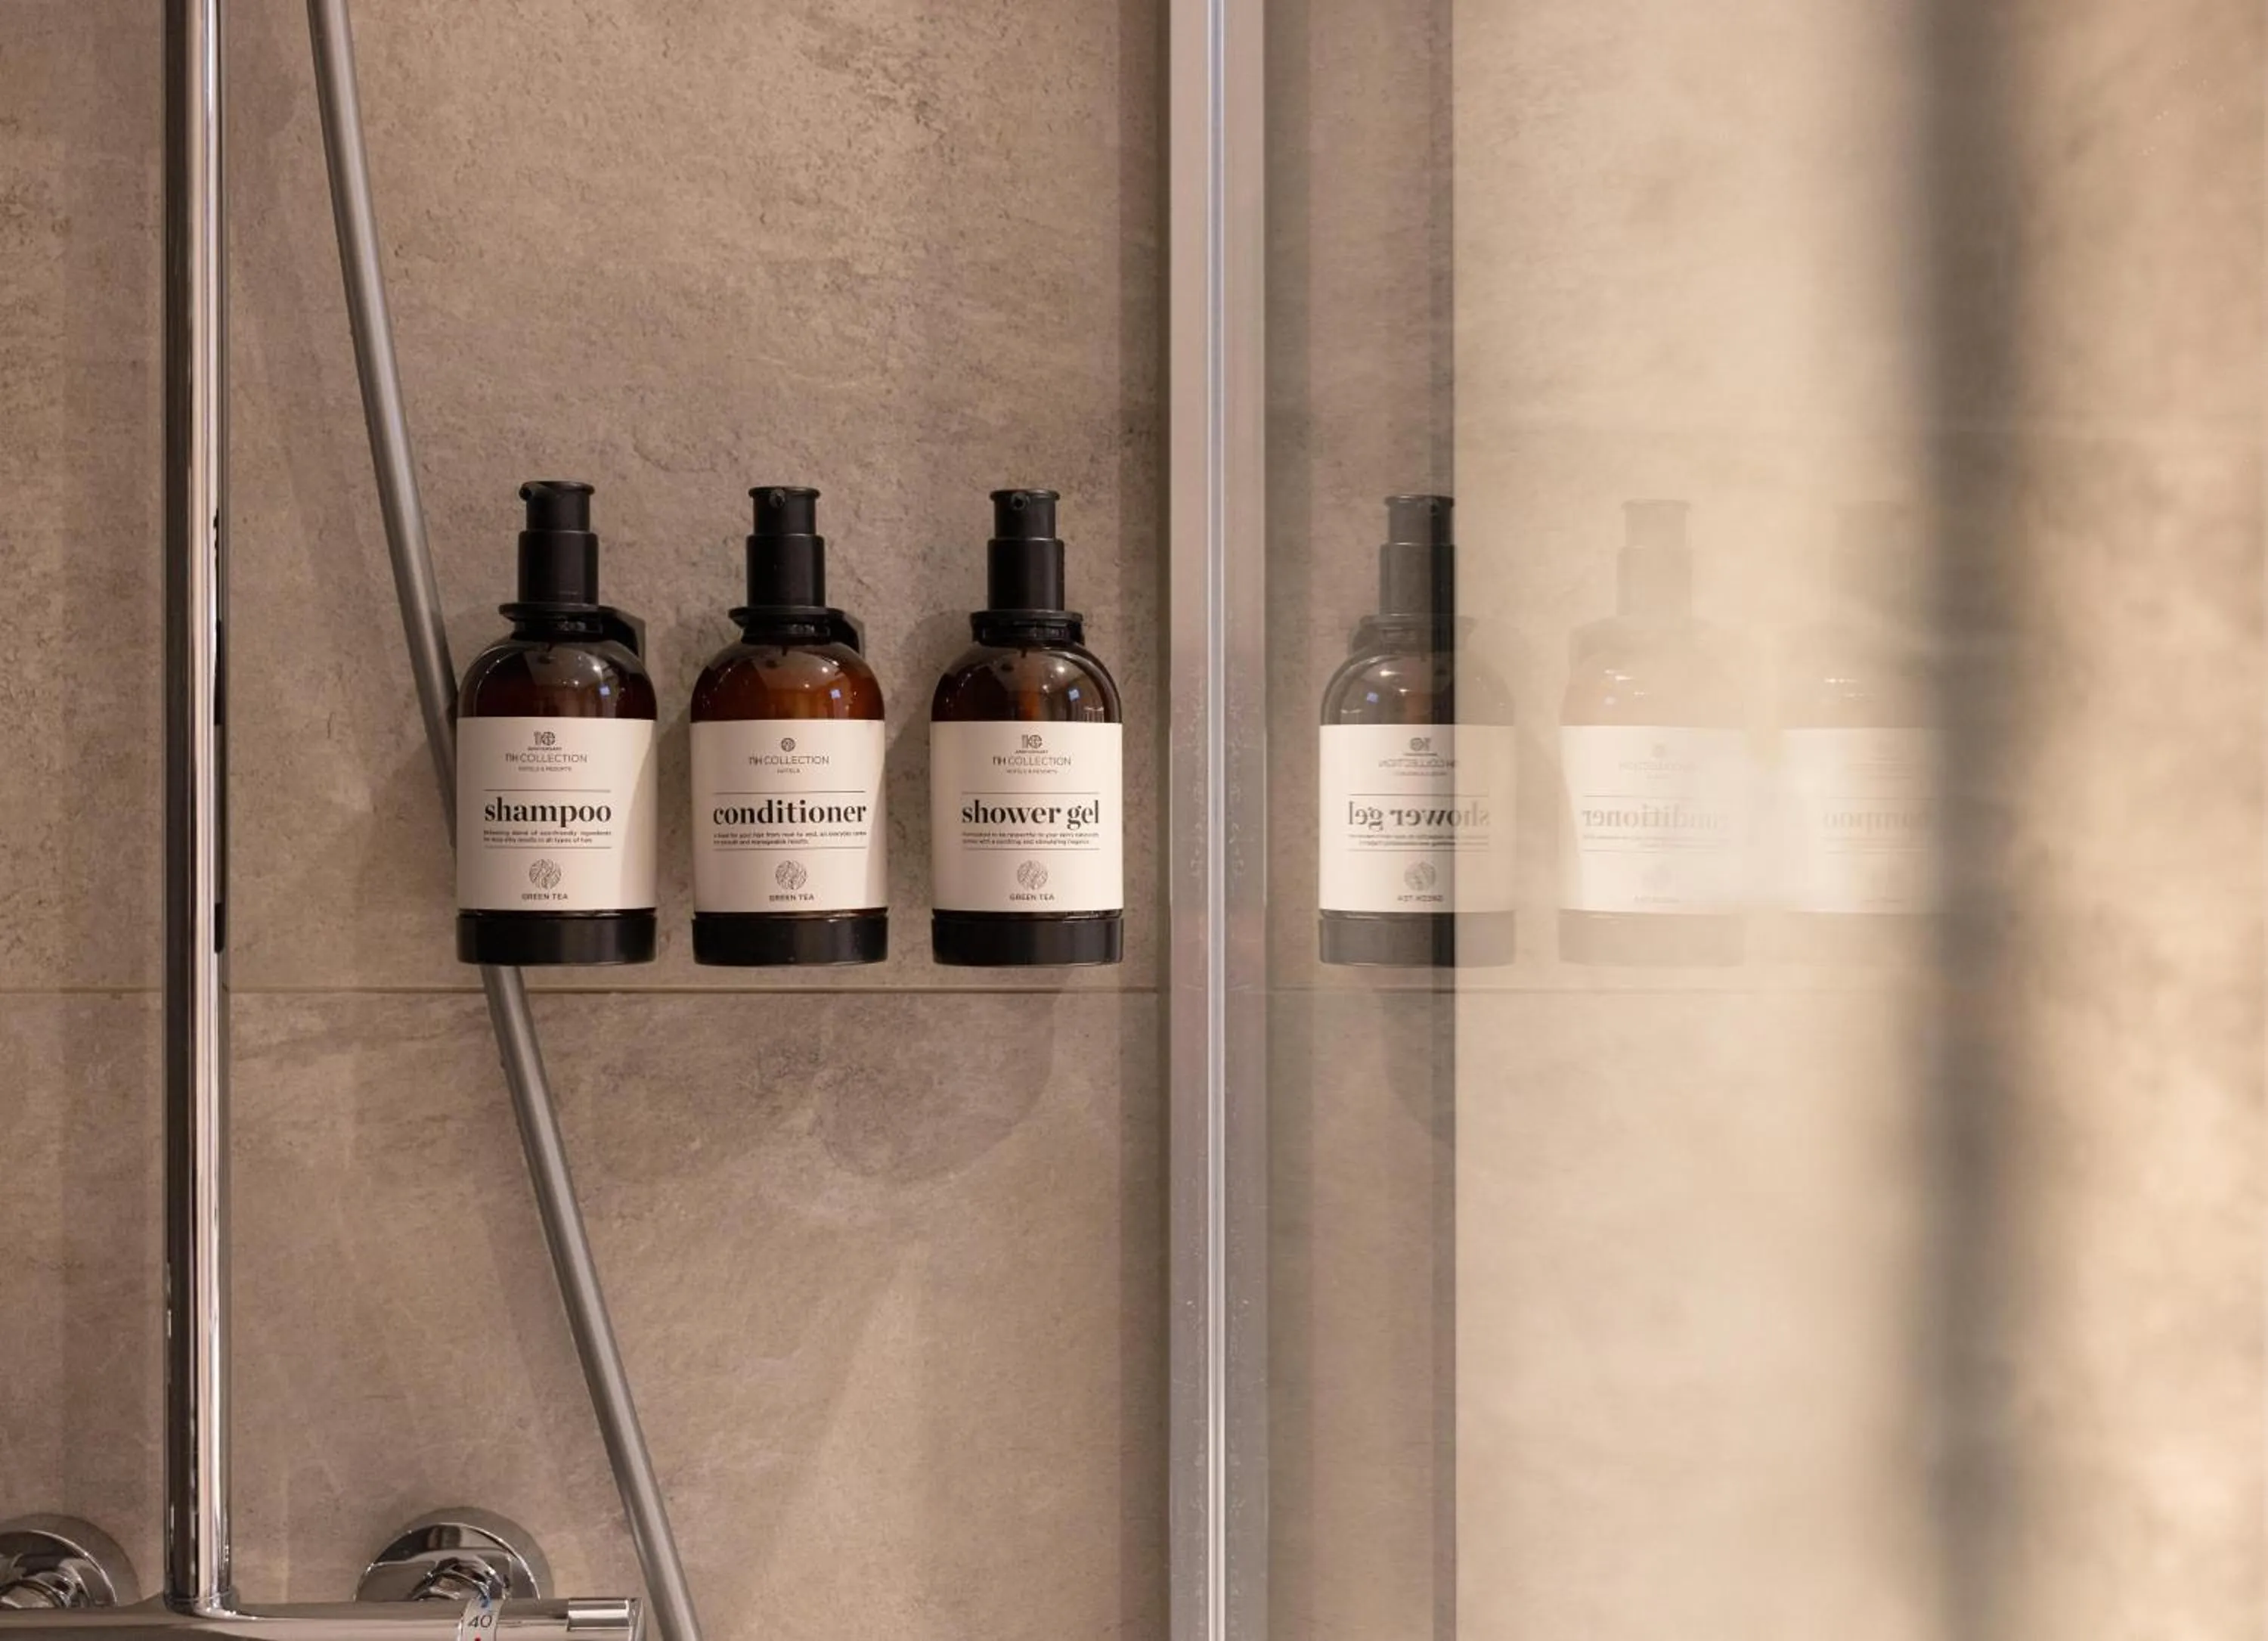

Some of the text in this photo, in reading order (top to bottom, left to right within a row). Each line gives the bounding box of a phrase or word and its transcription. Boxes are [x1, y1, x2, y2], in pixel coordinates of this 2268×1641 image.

[519, 753, 587, 763] COLLECTION
[764, 755, 829, 765] COLLECTION
[1008, 756, 1071, 766] COLLECTION
[485, 796, 612, 828] shampoo
[714, 799, 866, 825] conditioner
[962, 799, 1099, 830] shower gel
[769, 893, 815, 902] GREEN TEA
[467, 1615, 493, 1628] 40
